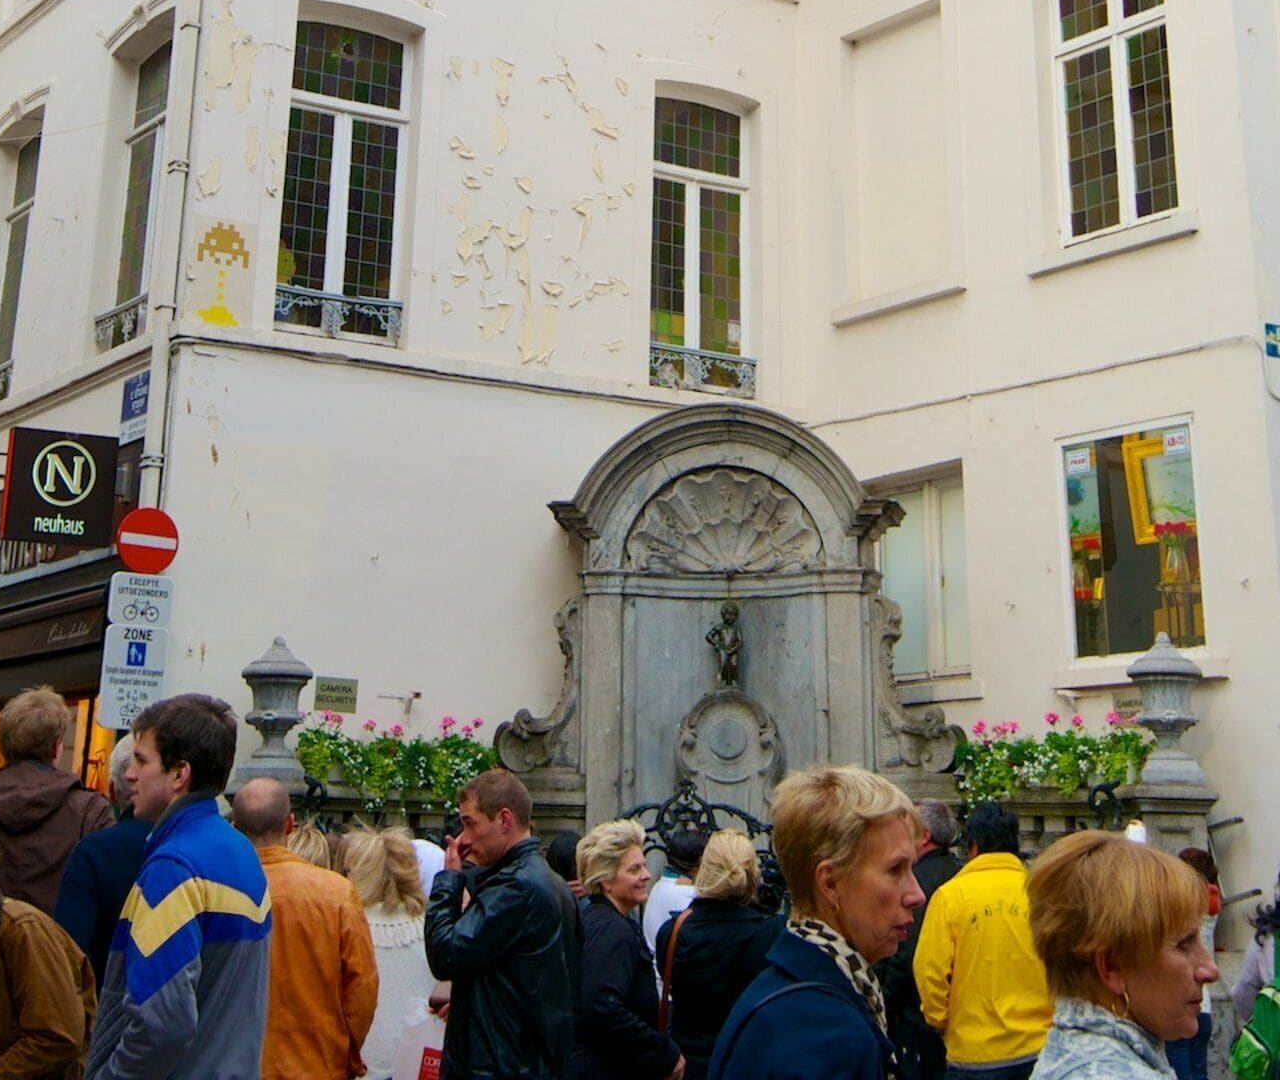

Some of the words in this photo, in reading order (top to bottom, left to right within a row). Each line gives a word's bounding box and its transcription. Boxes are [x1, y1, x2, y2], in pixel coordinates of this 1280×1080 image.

[34, 513, 85, 536] neuhaus
[123, 628, 153, 641] ZONE
[320, 684, 352, 693] CAMERA
